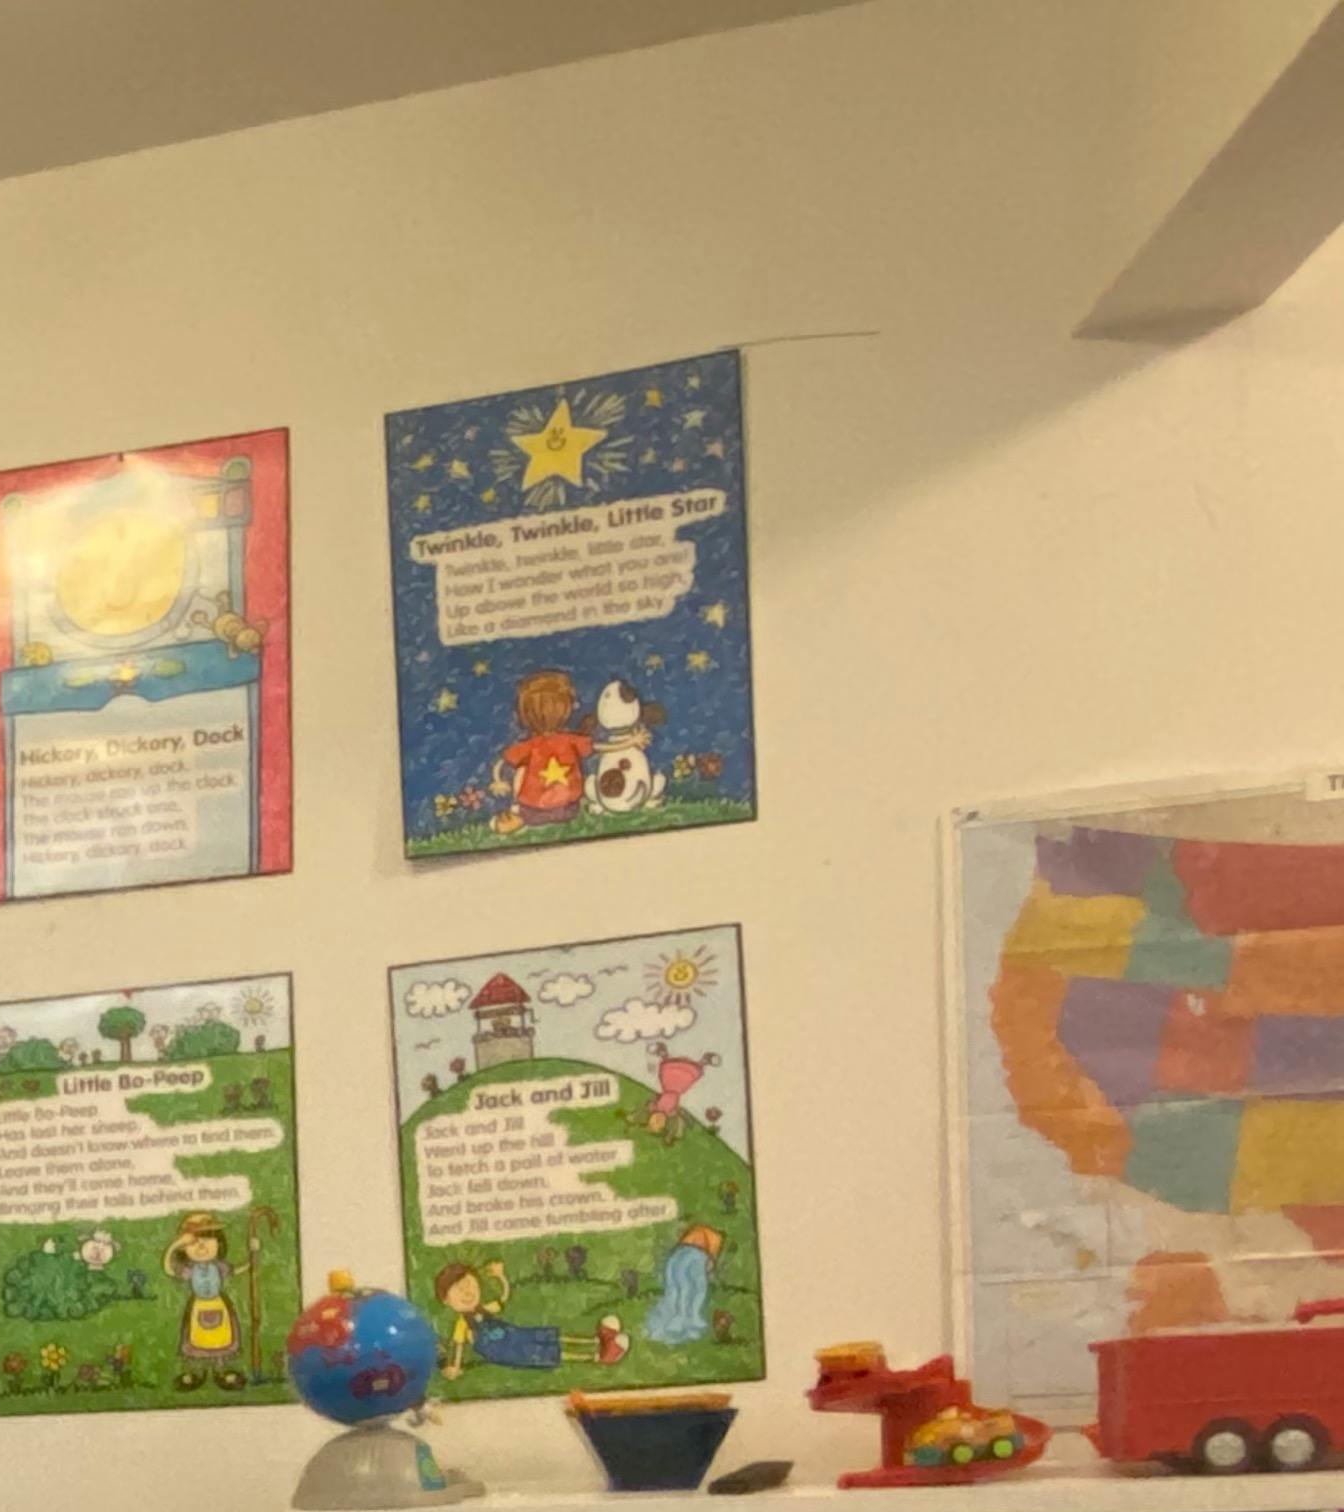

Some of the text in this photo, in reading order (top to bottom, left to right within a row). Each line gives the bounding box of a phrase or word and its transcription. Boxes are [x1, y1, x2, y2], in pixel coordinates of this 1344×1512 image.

[415, 491, 717, 561] Twinkle, Twinkle, Little Star
[20, 723, 243, 769] Hickory, Dickory, Dock
[63, 1064, 204, 1096] Little Bo-Peep
[472, 1077, 610, 1112] Jack and Jill
